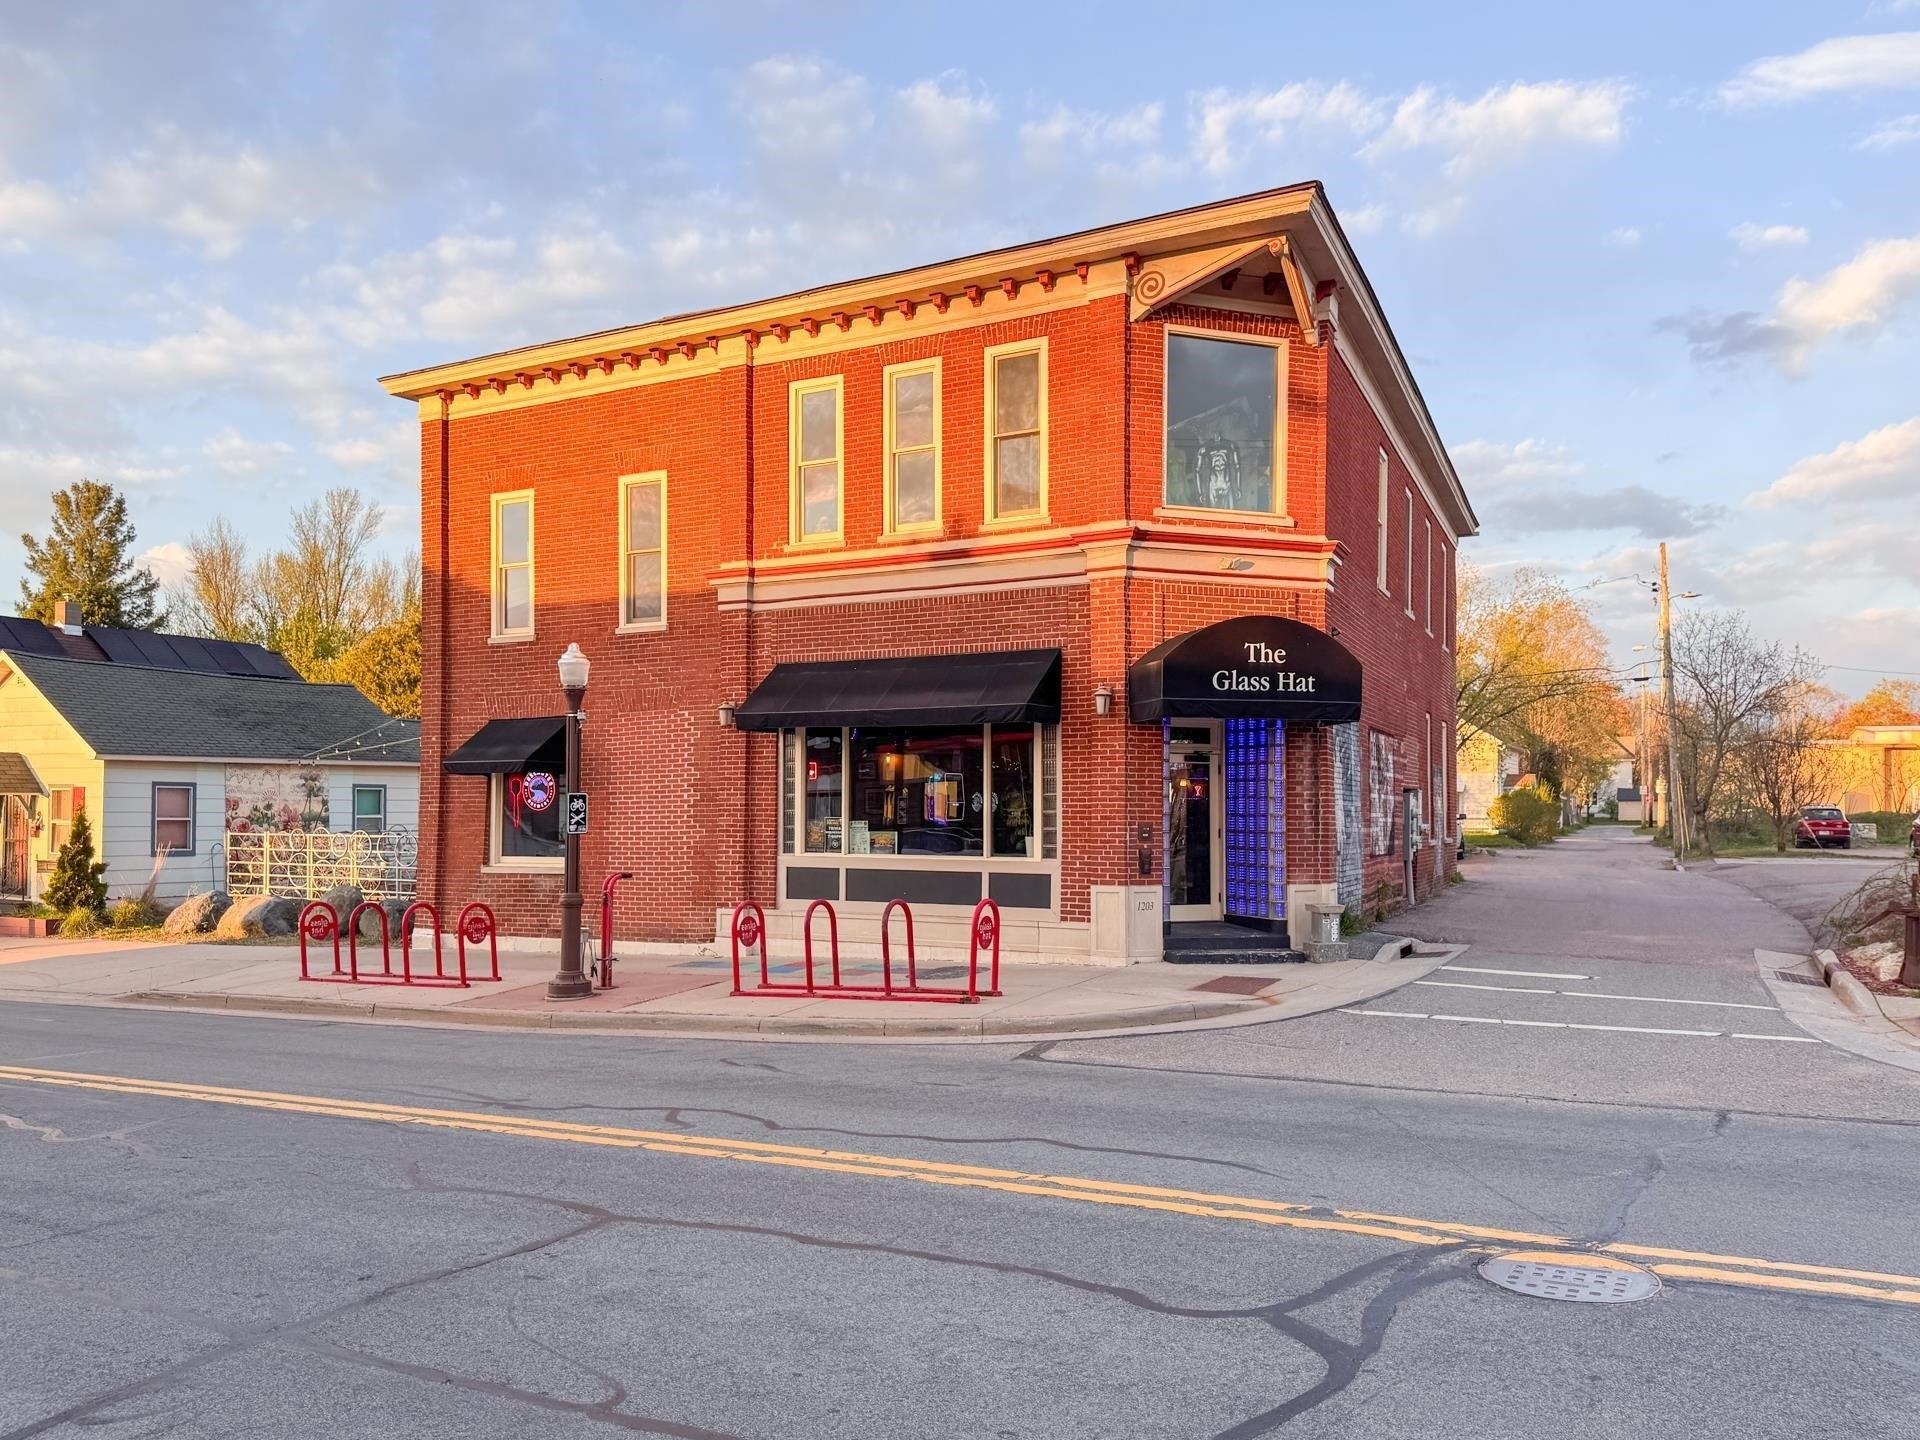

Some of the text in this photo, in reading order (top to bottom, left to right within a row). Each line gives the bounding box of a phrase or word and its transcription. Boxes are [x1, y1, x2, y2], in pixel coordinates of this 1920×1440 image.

[1244, 642, 1287, 664] The
[1212, 669, 1316, 692] Glass Hat
[1137, 901, 1154, 911] 1203
